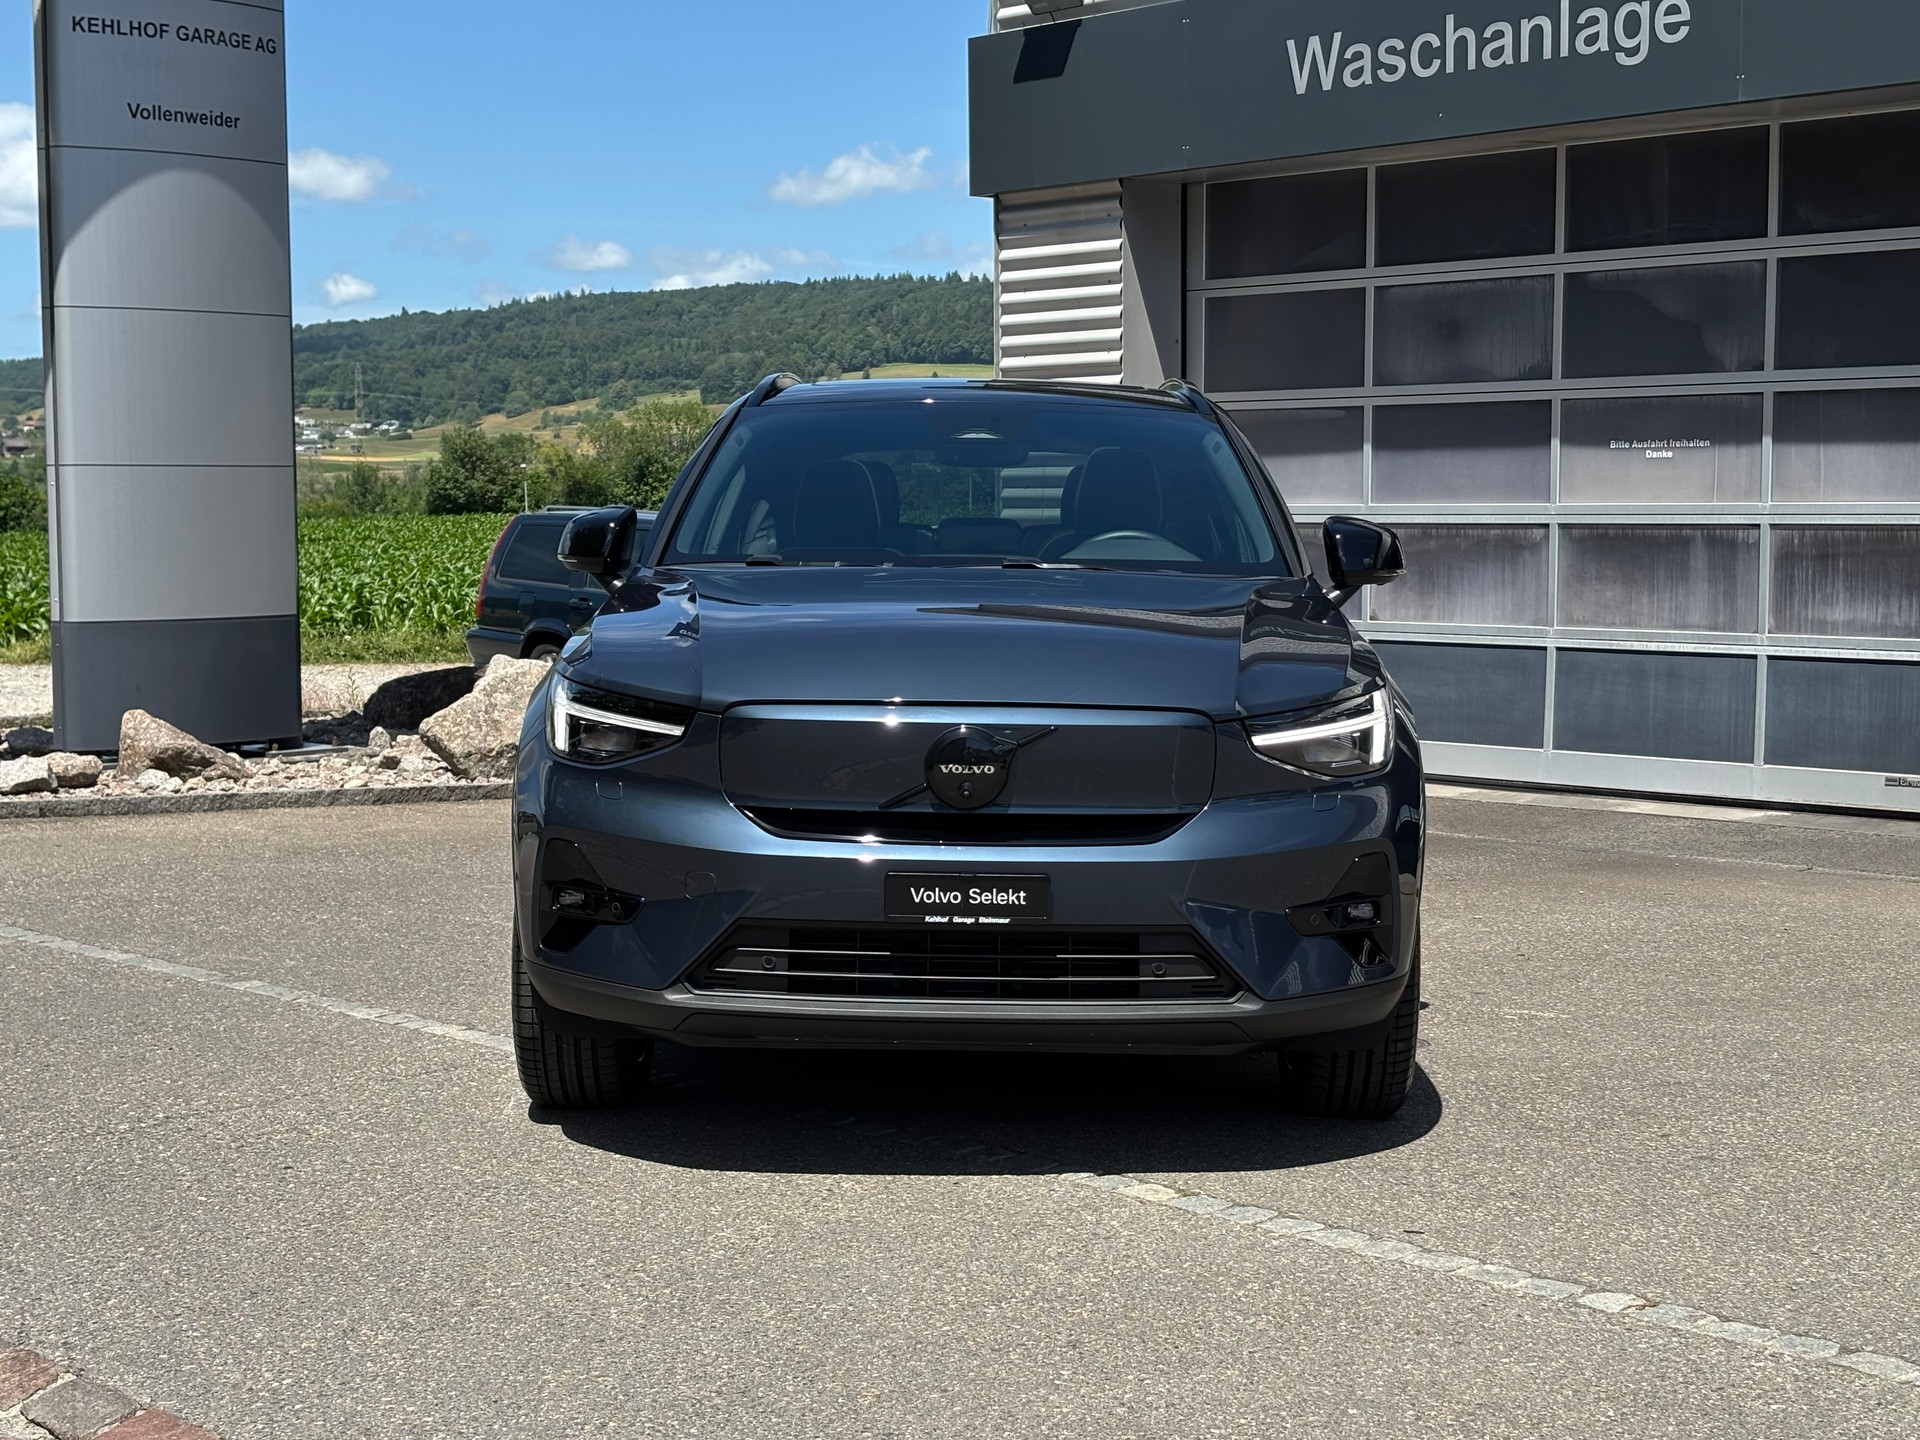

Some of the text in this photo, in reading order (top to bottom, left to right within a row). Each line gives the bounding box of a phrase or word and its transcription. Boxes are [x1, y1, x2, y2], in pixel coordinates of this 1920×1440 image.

[71, 15, 277, 54] KEHLHOF GARAGE AG
[1286, 0, 1691, 95] Waschanlage
[126, 102, 240, 129] Vollenweider
[1610, 439, 1711, 449] Bitte Ausfahrt freihalten
[1645, 450, 1673, 459] Danke
[939, 764, 995, 774] VOLVO
[910, 887, 1027, 905] Volvo Selekt
[952, 916, 976, 924] Garage
